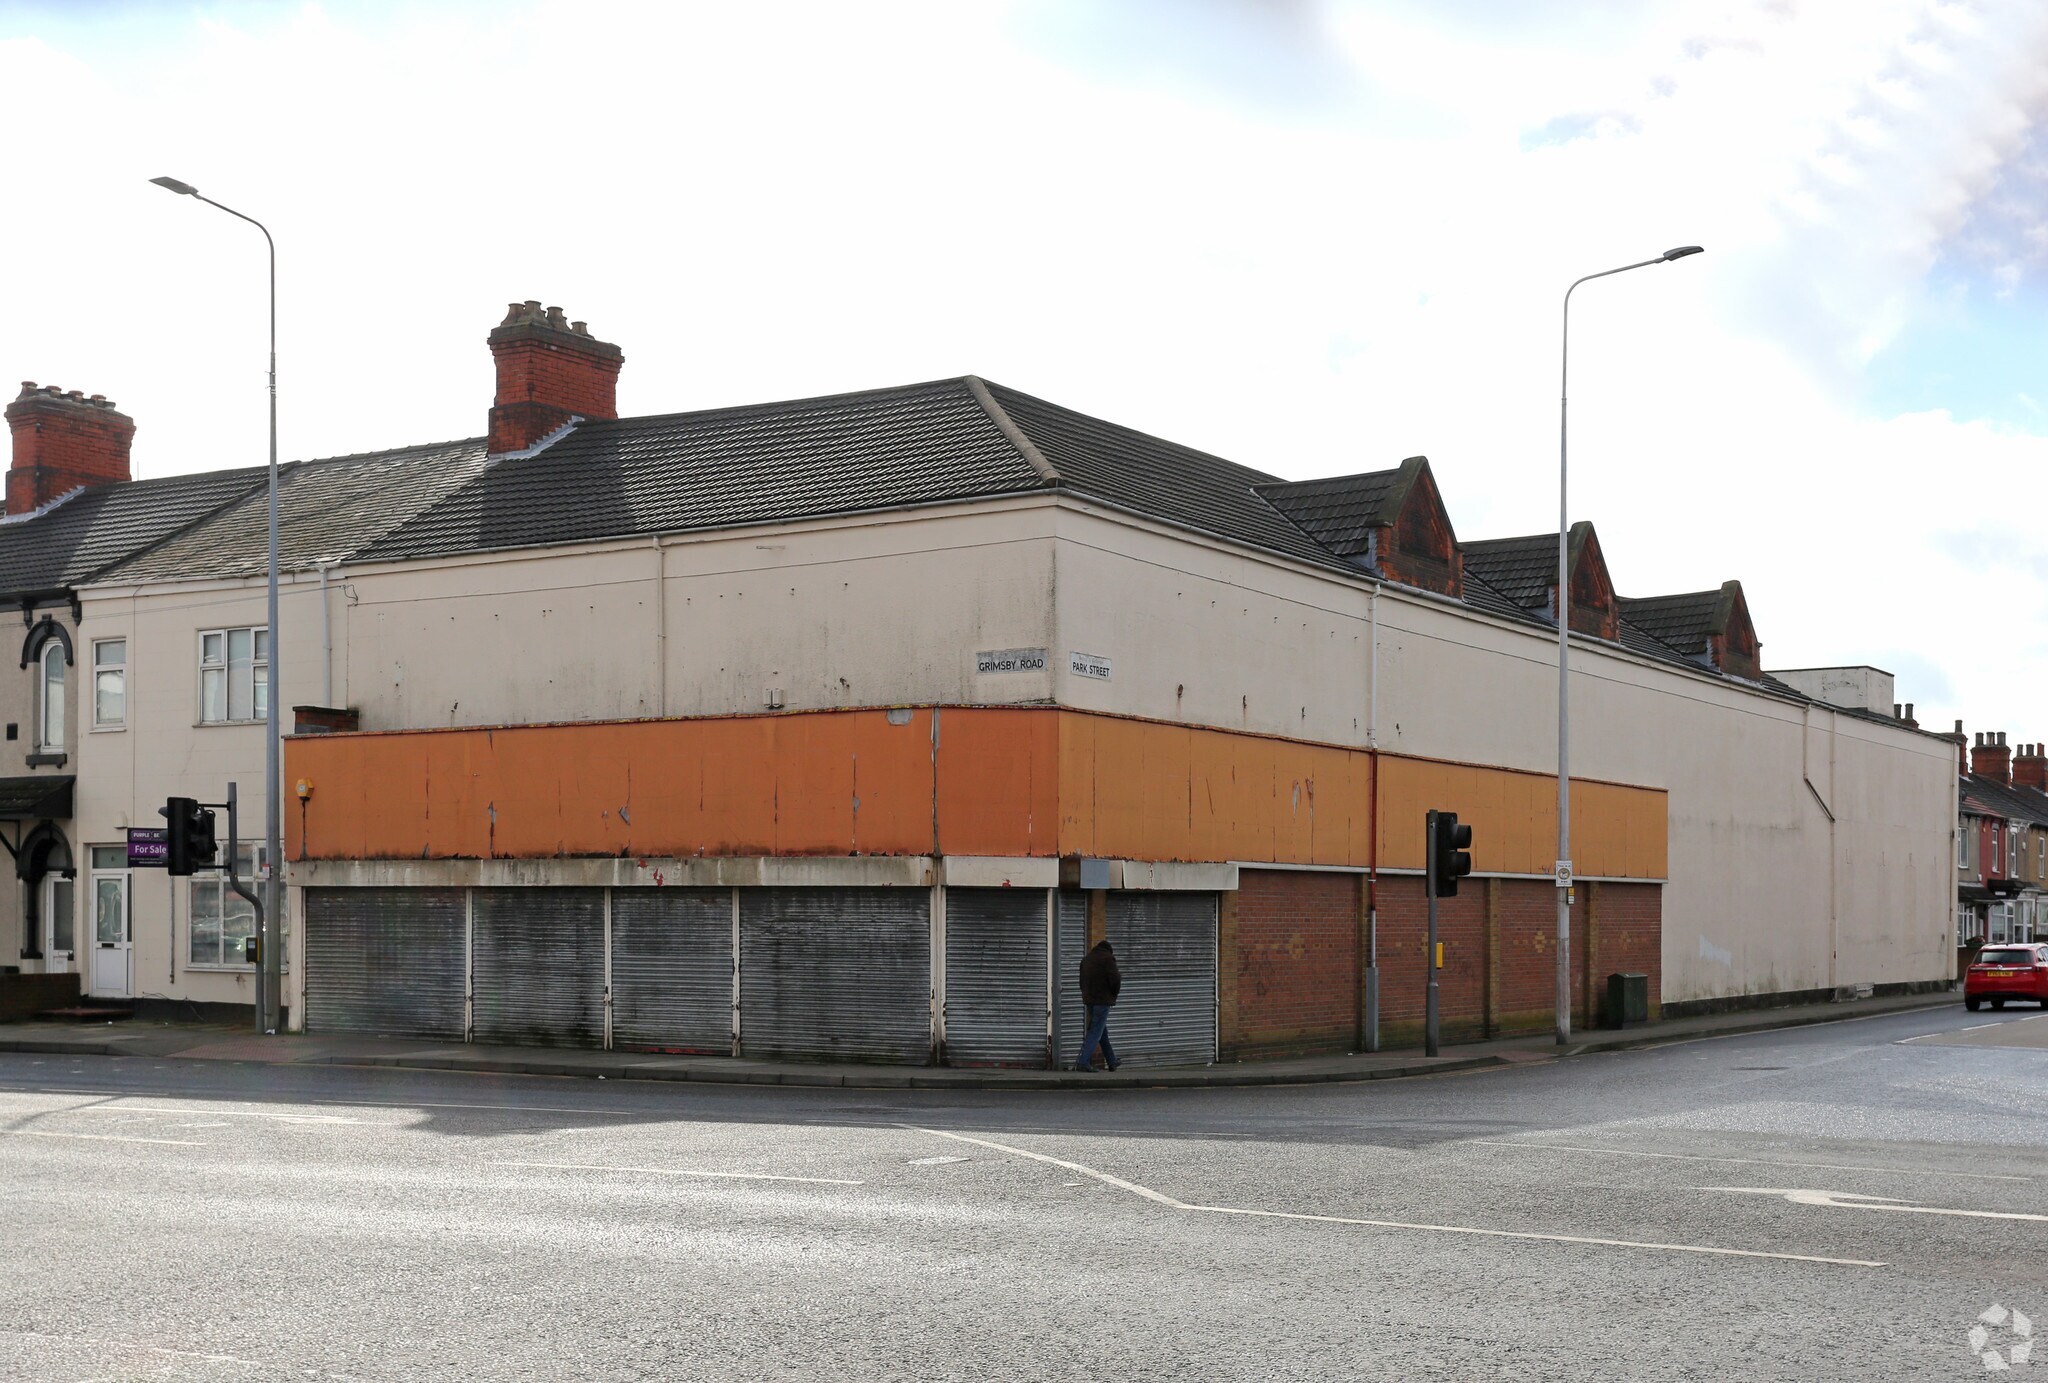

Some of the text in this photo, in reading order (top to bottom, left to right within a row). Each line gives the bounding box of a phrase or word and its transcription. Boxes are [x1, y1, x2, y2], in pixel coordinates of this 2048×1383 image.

[979, 659, 1044, 672] GRIMSBY ROAD
[1072, 662, 1110, 677] PARK STREET
[135, 845, 167, 854] For Sale
